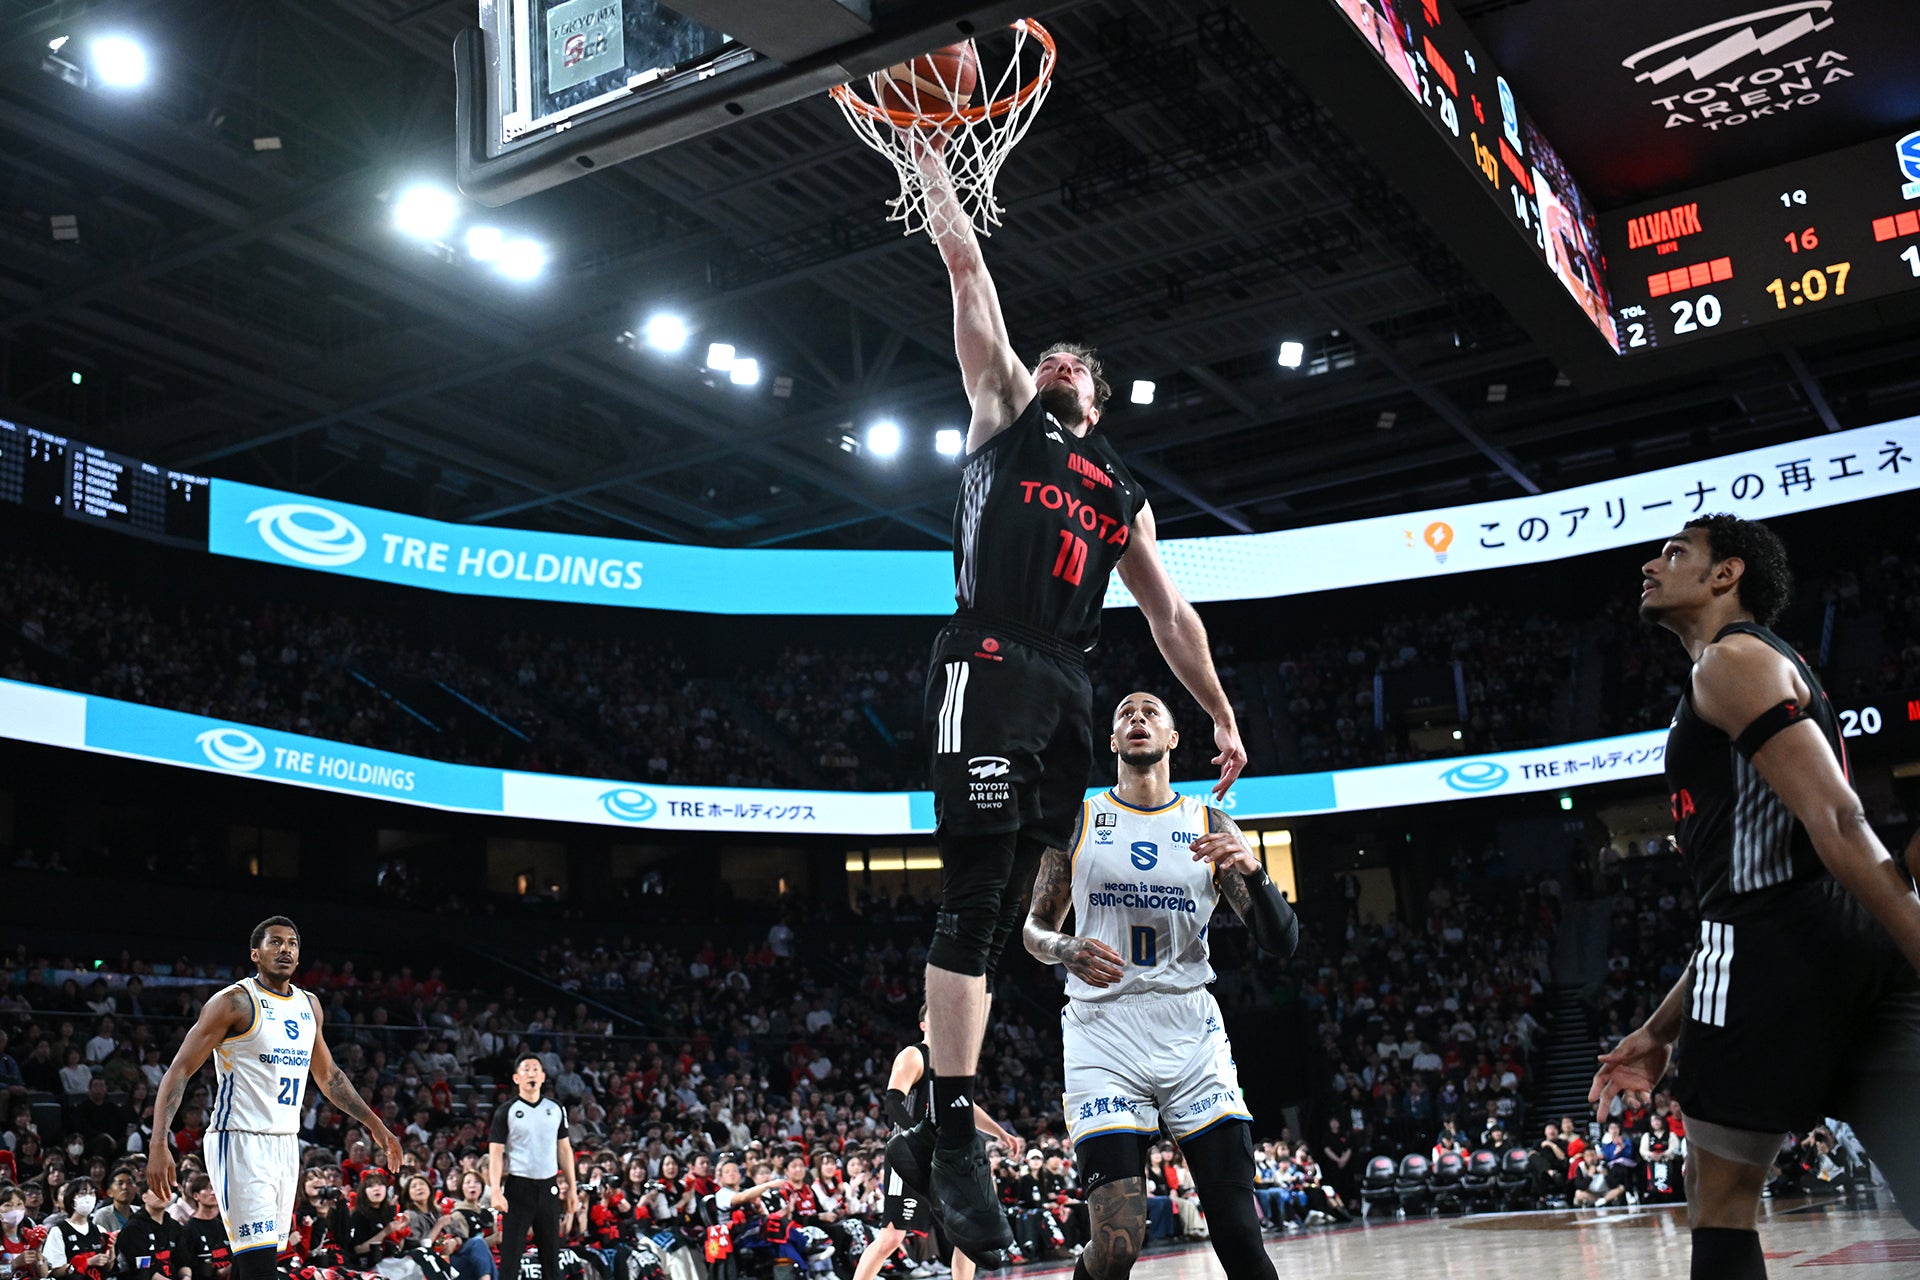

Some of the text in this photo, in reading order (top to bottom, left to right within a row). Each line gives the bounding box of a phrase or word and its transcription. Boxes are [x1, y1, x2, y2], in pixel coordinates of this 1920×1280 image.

[1651, 50, 1849, 111] TOYOTA
[1664, 67, 1855, 128] ARENA
[1702, 92, 1821, 131] TOKYO
[1780, 190, 1808, 208] 1Q
[1626, 202, 1703, 250] ALVARK
[1784, 226, 1819, 254] 16
[1765, 261, 1852, 310] 1:07
[1620, 304, 1647, 320] TOL
[1670, 294, 1722, 335] 20
[1626, 323, 1647, 348] 2
[1020, 480, 1129, 546] TOYOTA
[1479, 440, 1913, 549] このアリーナの再エネ
[381, 533, 644, 590] TRE HOLDINGS
[1052, 529, 1089, 587] 10
[1839, 706, 1882, 738] 20
[274, 747, 416, 791] TRE HOLDINGS
[969, 782, 1010, 791] TOYOTA
[969, 792, 1010, 801] ARENA
[277, 1076, 300, 1107] 21
